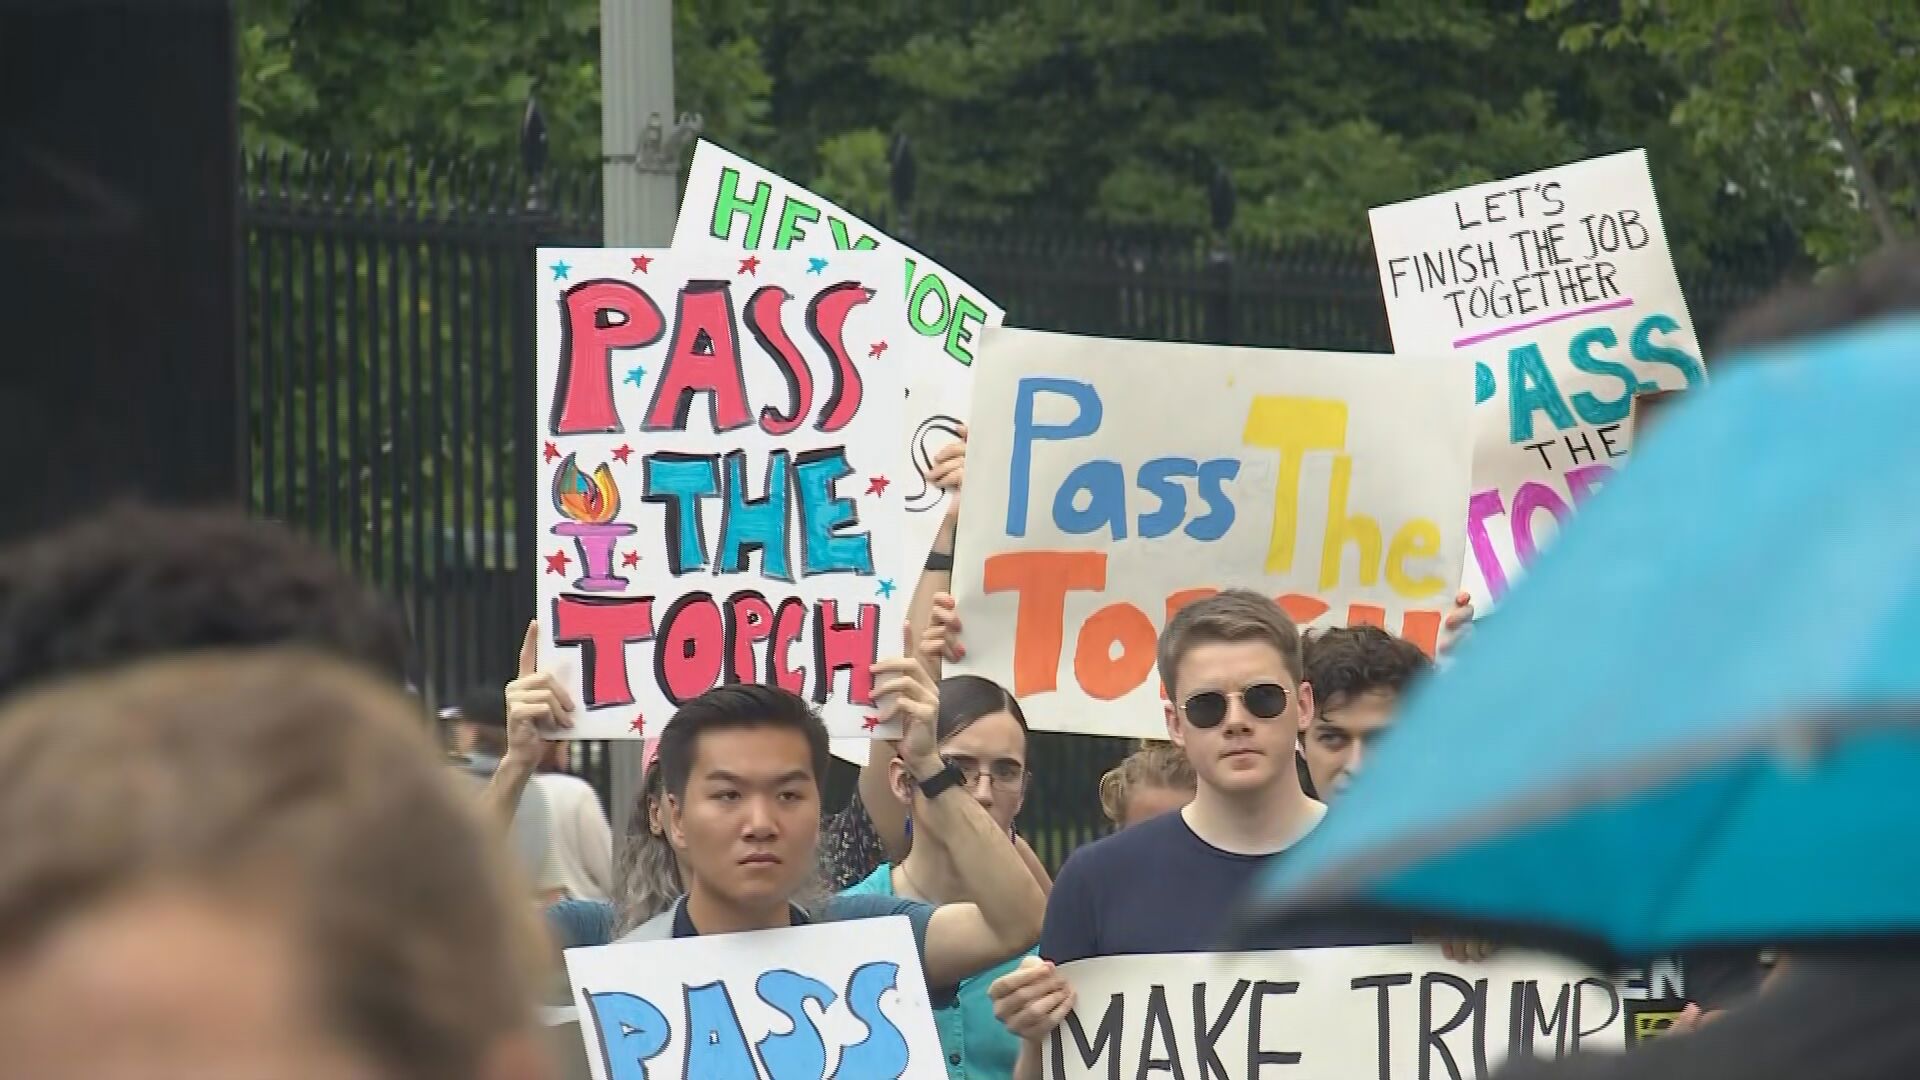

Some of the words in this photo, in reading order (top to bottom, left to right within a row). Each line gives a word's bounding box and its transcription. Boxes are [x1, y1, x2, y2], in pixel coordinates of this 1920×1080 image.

[1388, 240, 1500, 298] FINISH
[1509, 223, 1573, 275] THE
[1579, 209, 1650, 260] JOB
[1455, 182, 1565, 231] LET'S
[905, 257, 987, 367] OE
[1443, 261, 1622, 328] TOGETHER
[549, 277, 877, 435] PASS
[1475, 313, 1709, 444] ASS
[1242, 394, 1447, 598] The
[1524, 424, 1629, 470] THE
[641, 445, 874, 583] THE
[582, 961, 909, 1080] PASS
[1049, 979, 1301, 1080] MAKE
[1350, 971, 1620, 1080] TRUMP
